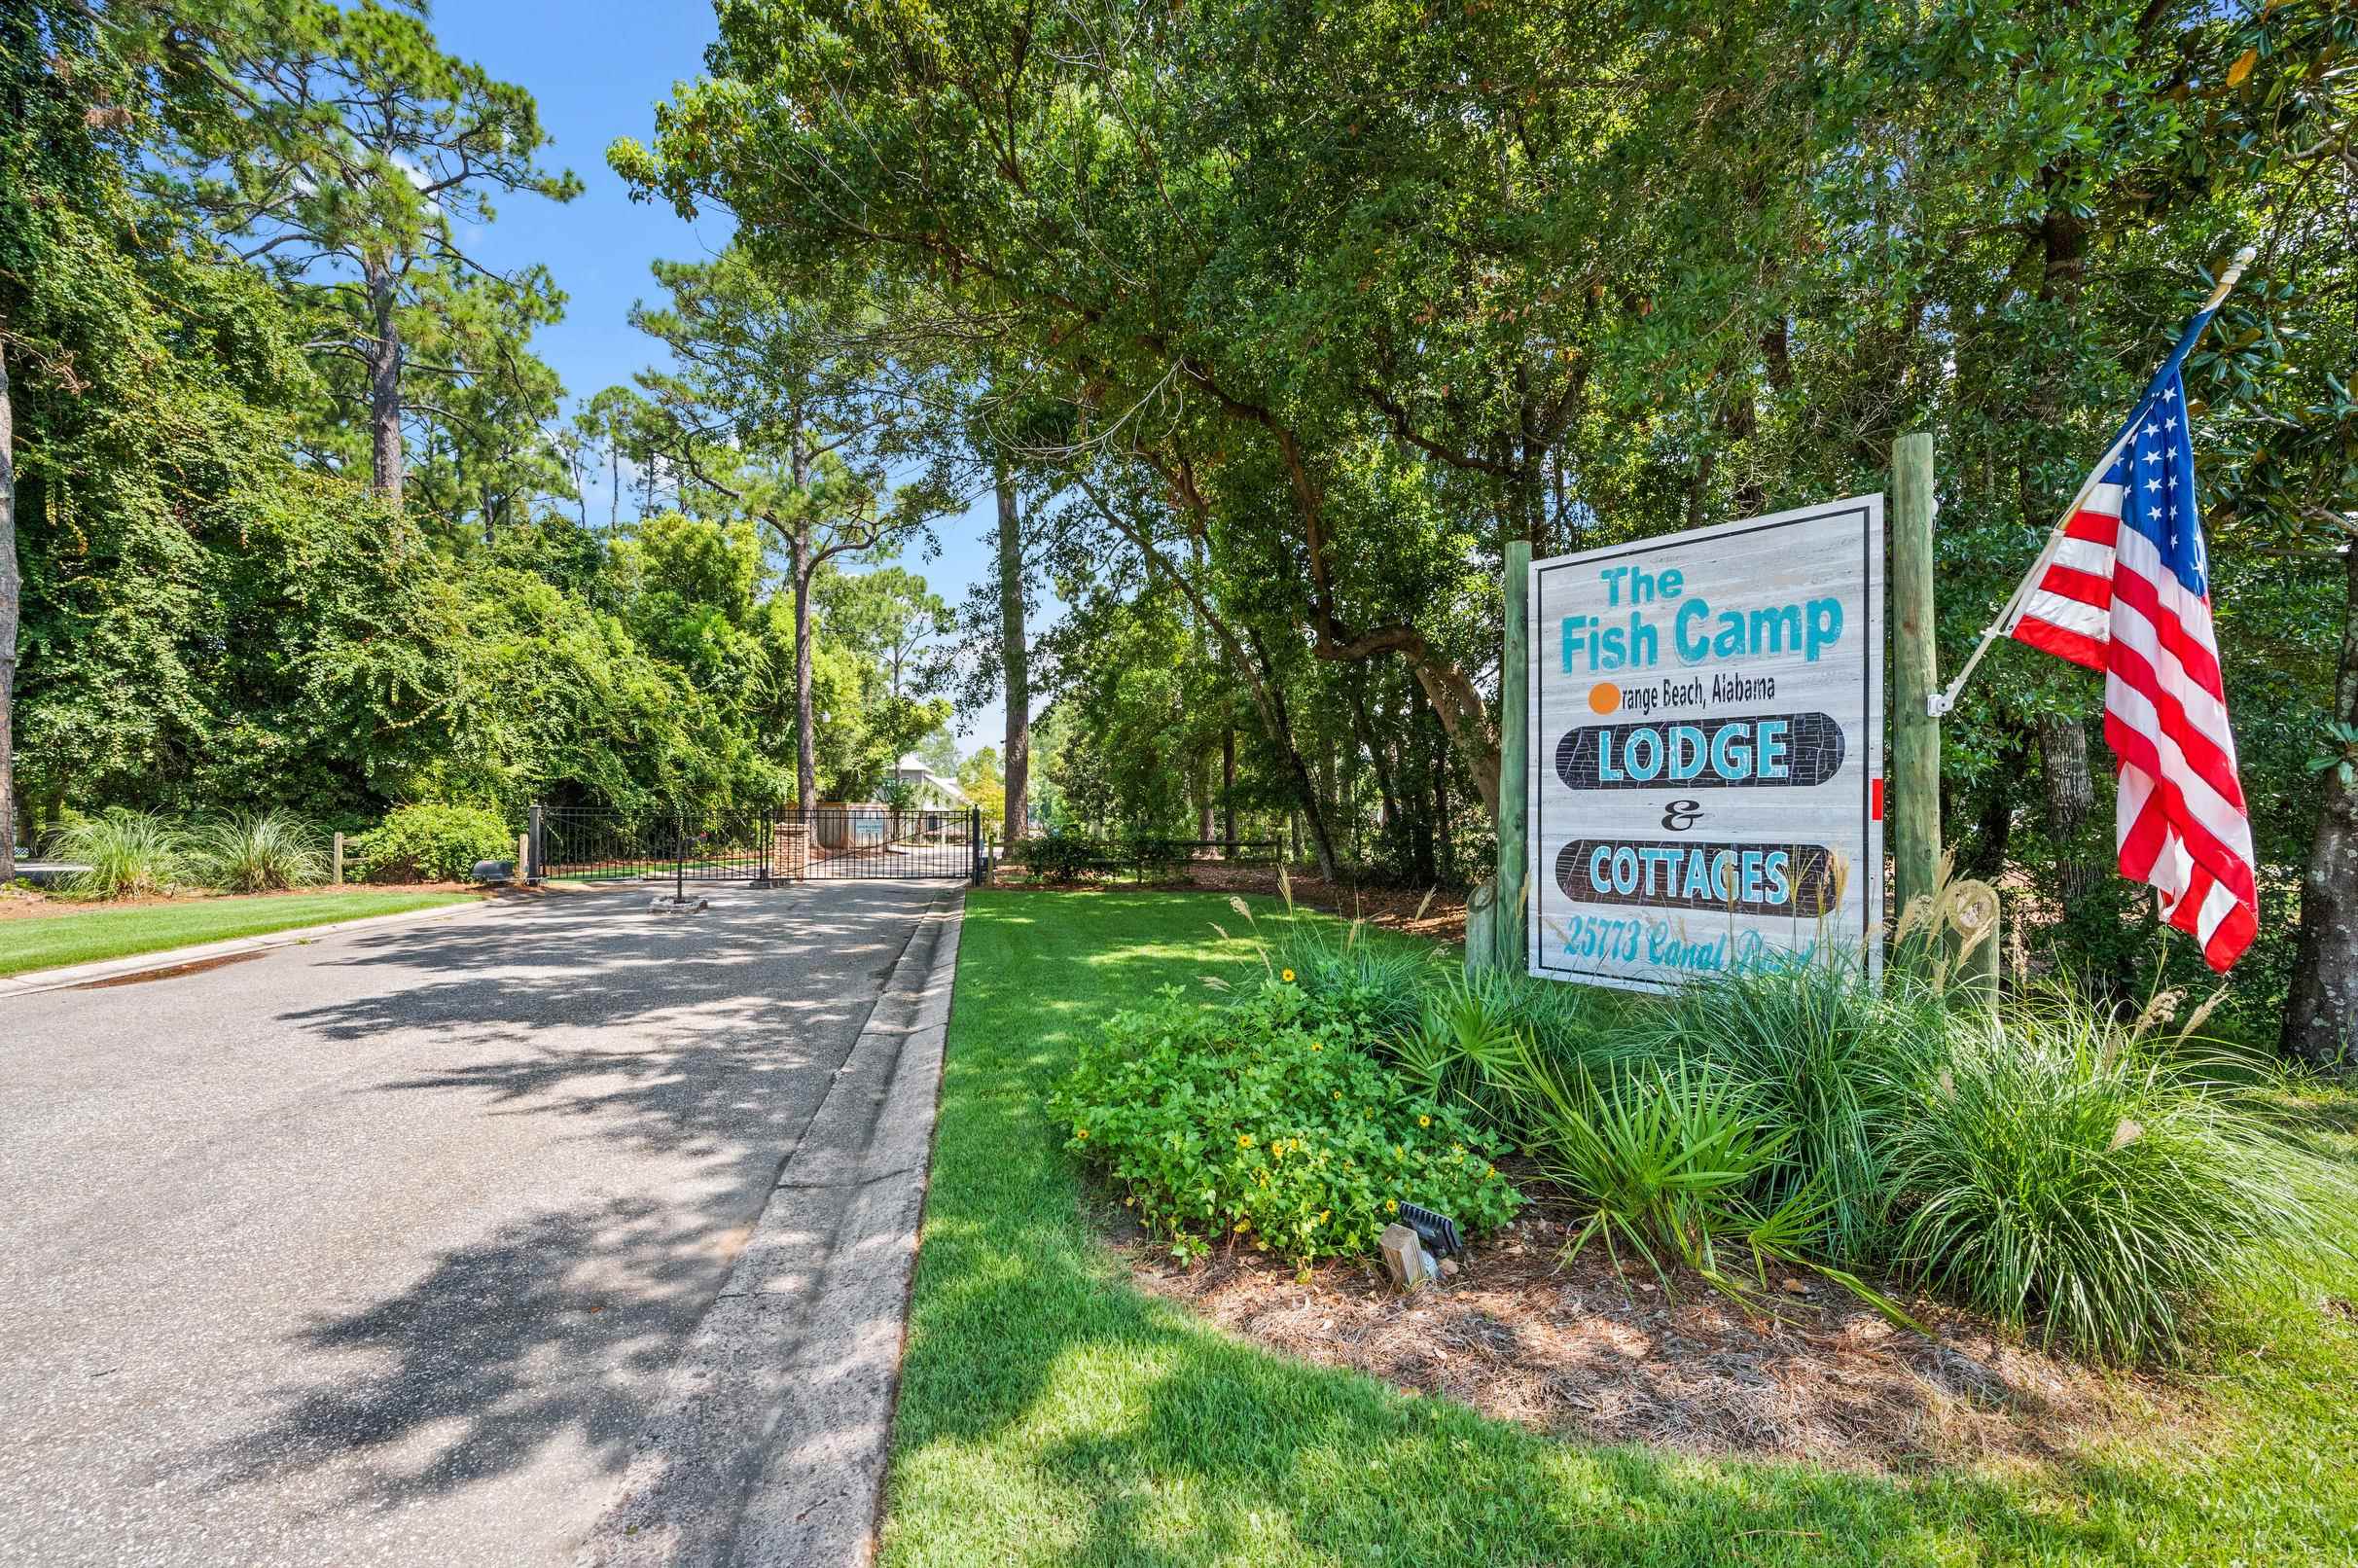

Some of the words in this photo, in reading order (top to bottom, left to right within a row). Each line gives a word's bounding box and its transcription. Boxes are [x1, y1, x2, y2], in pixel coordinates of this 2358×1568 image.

[1601, 566, 1685, 607] The
[1560, 610, 1659, 674] Fish
[1673, 597, 1844, 666] Camp
[1663, 677, 1706, 710] Beach,
[1712, 672, 1775, 704] Alabama
[1598, 720, 1790, 781] LODGE
[1661, 800, 1704, 831] &
[1590, 845, 1791, 904] COTTAGES
[1564, 914, 1642, 962] 25773
[1646, 917, 1728, 971] Canal
